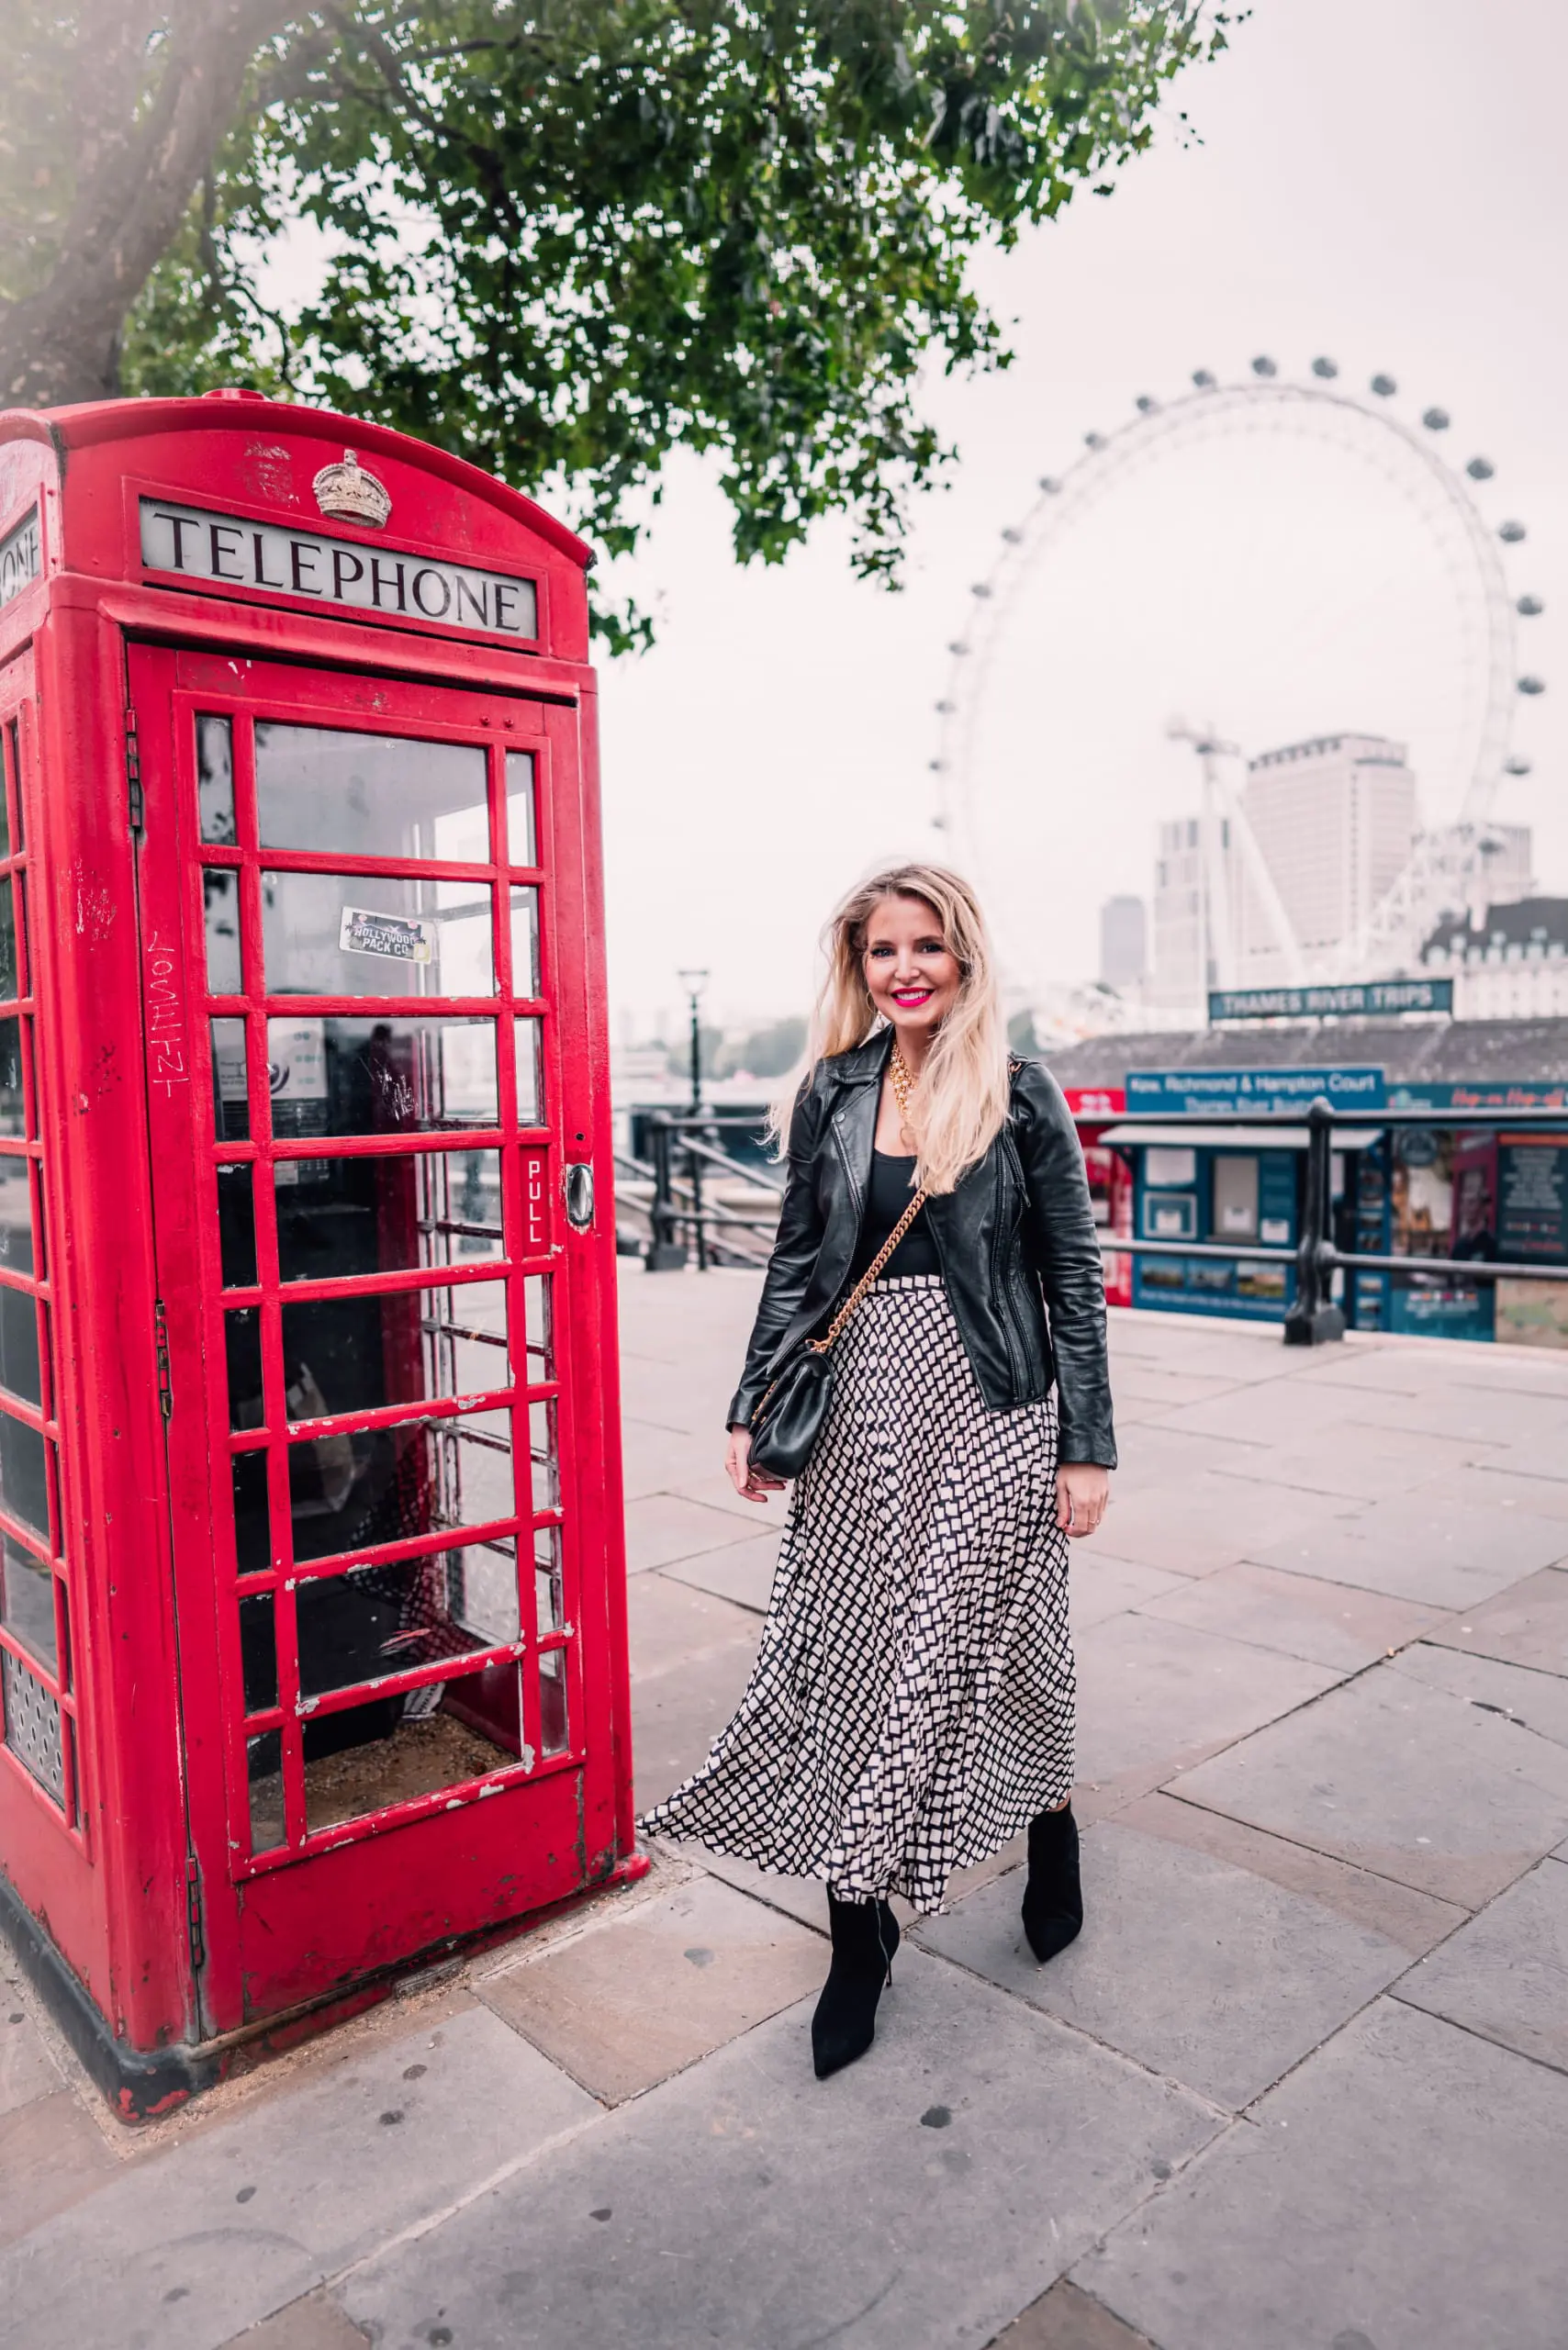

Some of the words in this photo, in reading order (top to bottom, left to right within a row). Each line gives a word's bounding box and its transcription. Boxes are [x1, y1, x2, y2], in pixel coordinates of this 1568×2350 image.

[153, 512, 521, 632] TELEPHONE
[353, 926, 417, 946] HOLLYWOOD
[363, 937, 391, 953] PACK
[394, 944, 409, 956] CO
[1222, 992, 1302, 1014] THAMES
[1306, 989, 1365, 1012] RIVER
[1372, 985, 1433, 1008] TRIPS
[1165, 1075, 1238, 1092] Richmond
[1240, 1075, 1252, 1092] &
[1255, 1076, 1325, 1095] Hampton
[1328, 1073, 1375, 1092] Court
[528, 1160, 542, 1242] PULL
